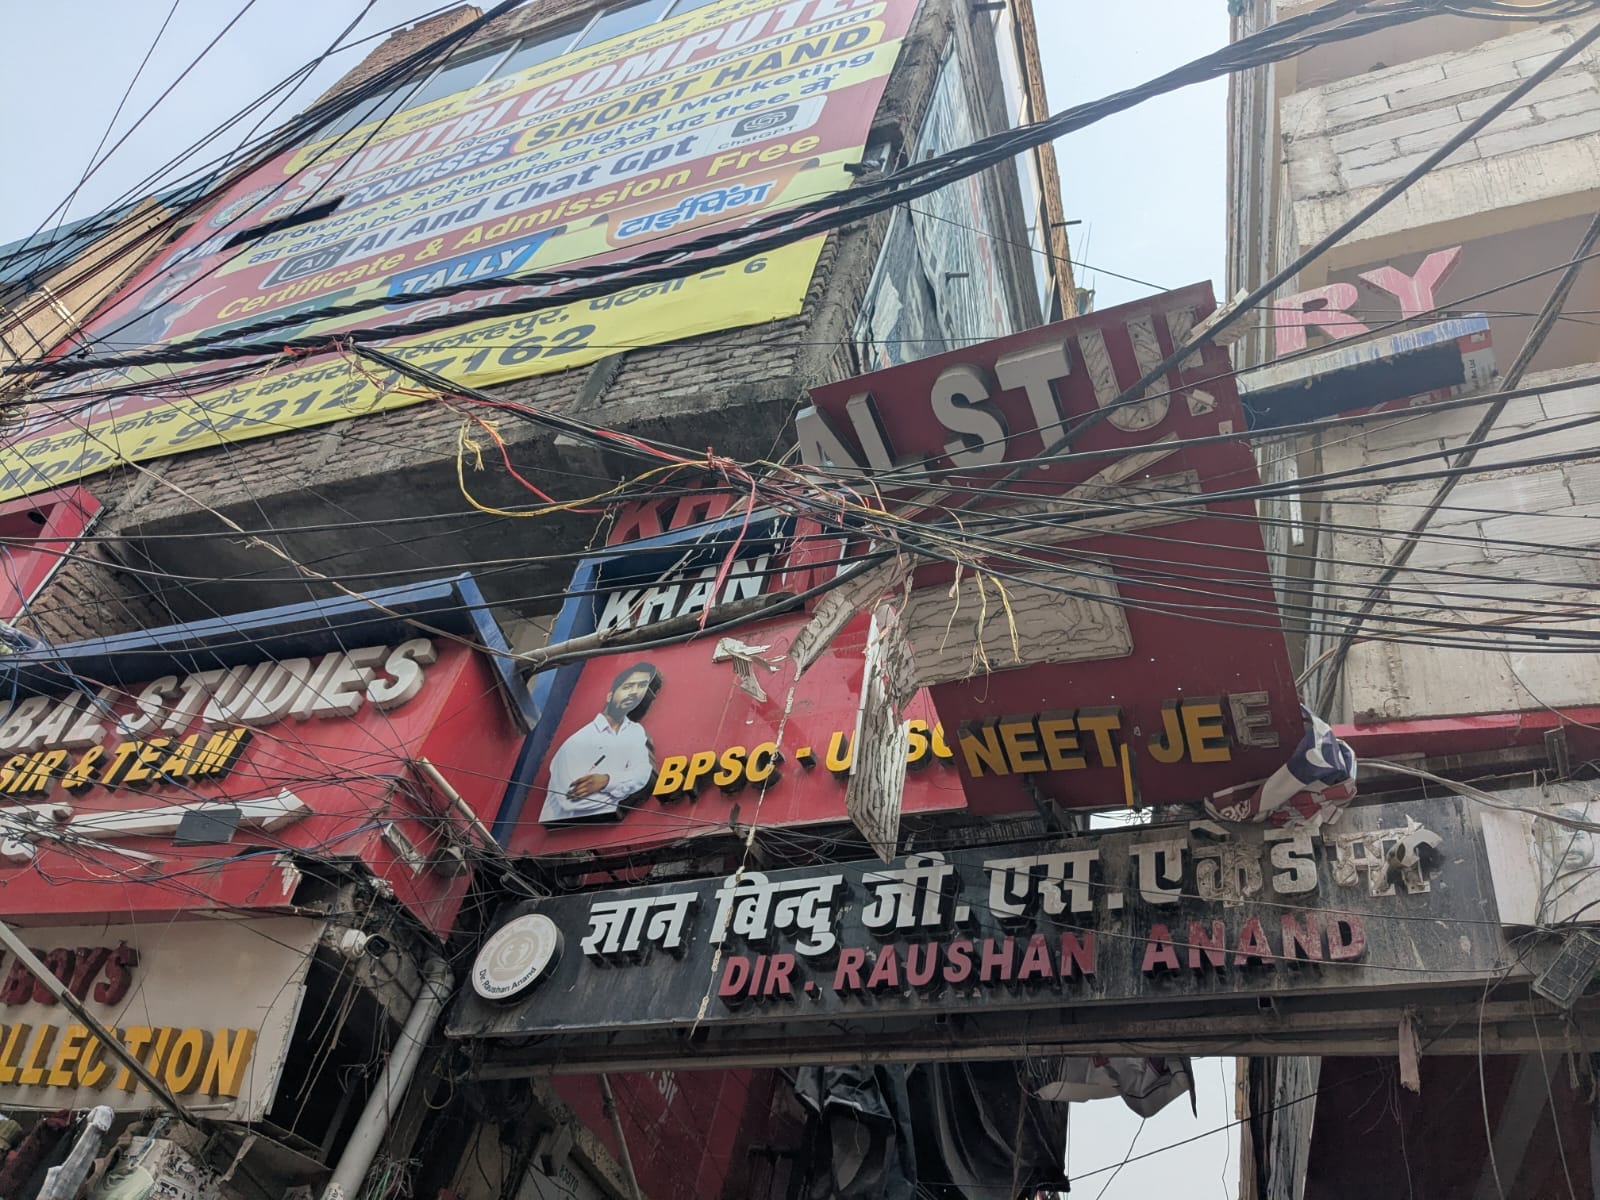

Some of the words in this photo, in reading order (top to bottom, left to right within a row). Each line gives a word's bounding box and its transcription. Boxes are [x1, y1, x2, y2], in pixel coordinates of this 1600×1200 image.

[526, 75, 705, 147] SHORT
[711, 26, 871, 87] HAND
[560, 104, 676, 153] Digital
[679, 51, 875, 114] Marketing
[708, 92, 791, 121] free
[285, 96, 519, 201] SAVITRI
[343, 138, 511, 208] COURSES
[717, 125, 799, 150] ChatGPT
[217, 252, 405, 319] Certificate
[414, 236, 444, 262] &
[451, 168, 692, 250] Admission
[706, 135, 821, 178] Free
[347, 228, 397, 257] AI
[398, 197, 489, 242] And
[493, 163, 602, 212] Chat
[609, 134, 701, 177] Gpt
[615, 180, 778, 239] टाईपिंग
[400, 243, 530, 296] TALLY
[743, 257, 768, 275] 6
[0, 450, 112, 491] Mob.
[596, 553, 770, 632] KHAN
[0, 688, 118, 751] BAL
[115, 639, 438, 738] STUDIES
[0, 750, 68, 795] SIR
[61, 745, 105, 789] &
[101, 729, 253, 790] TEAM
[957, 713, 1122, 779] NEET
[1147, 691, 1281, 764] JEE
[651, 747, 779, 801] BPSC
[709, 871, 845, 956] बिन्दु
[832, 931, 1097, 991] RAUSHAN
[1141, 912, 1368, 974] ANAND
[482, 980, 510, 994] Raushan
[511, 966, 537, 990] Anand
[0, 1022, 257, 1098] LLECTION
